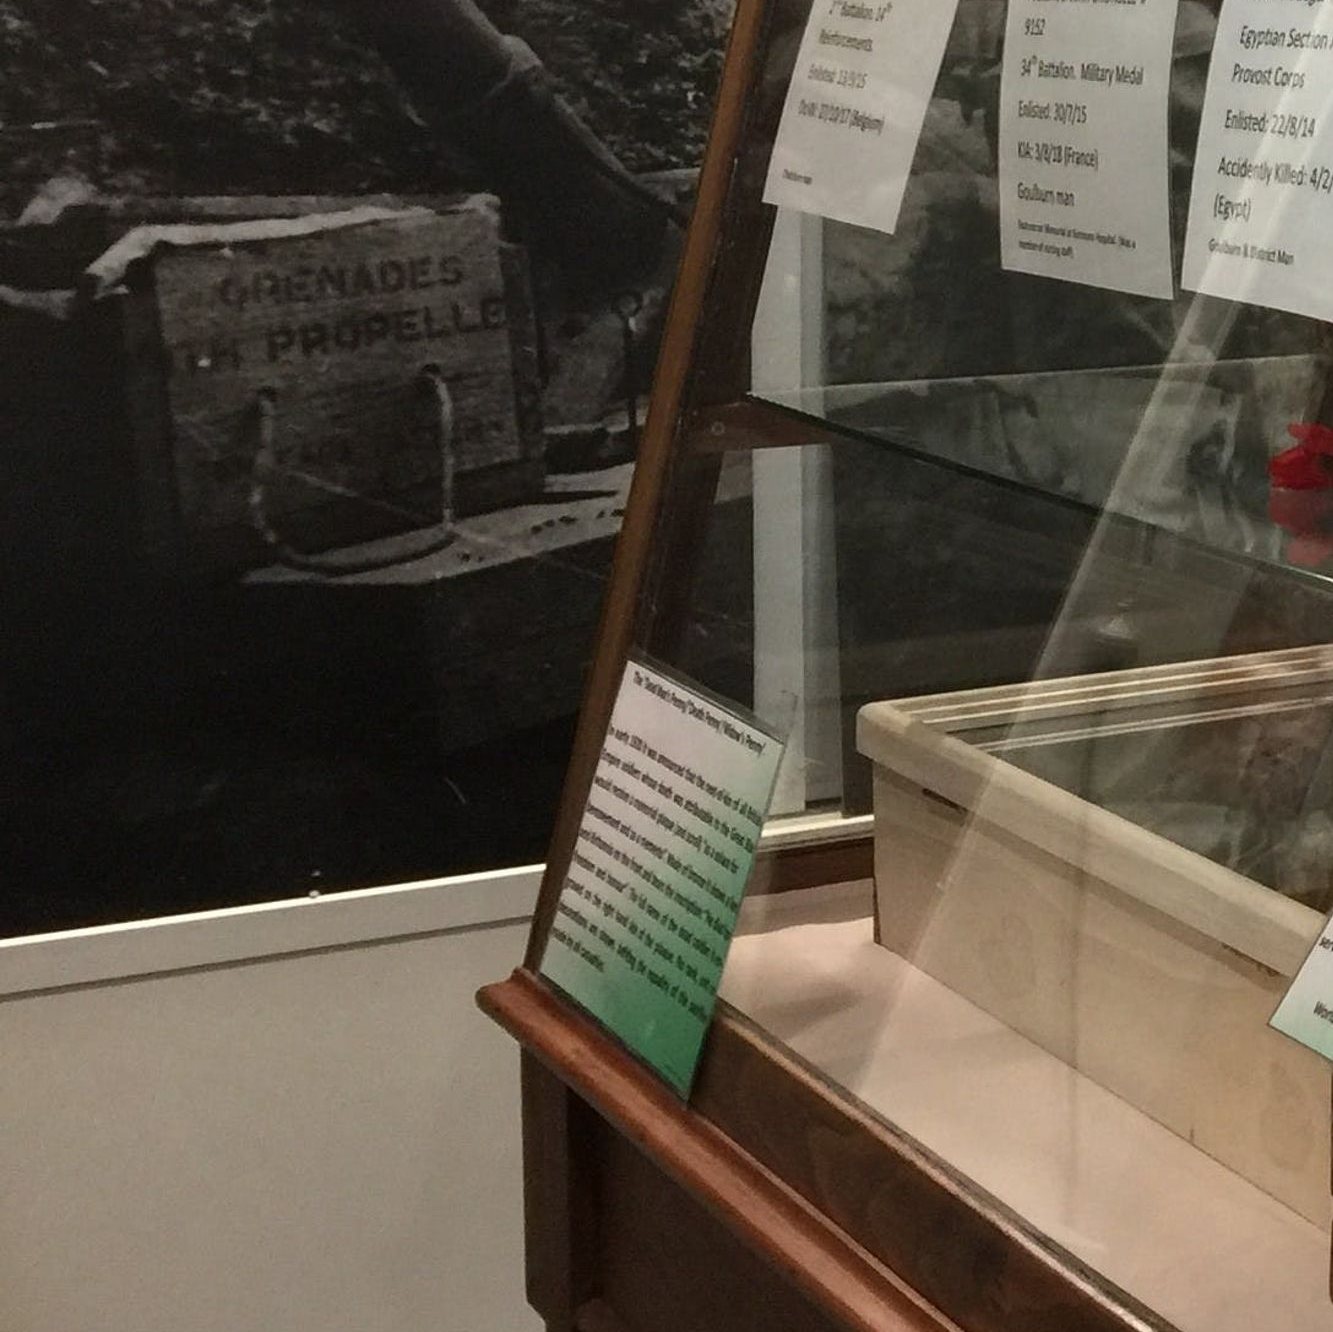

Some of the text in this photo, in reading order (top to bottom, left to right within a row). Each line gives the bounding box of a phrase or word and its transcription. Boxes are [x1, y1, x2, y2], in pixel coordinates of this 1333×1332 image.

[1240, 25, 1286, 49] Egyptian
[1287, 28, 1328, 48] Section
[1232, 64, 1305, 89] Provost Corps
[1225, 109, 1269, 133] Enlisted:
